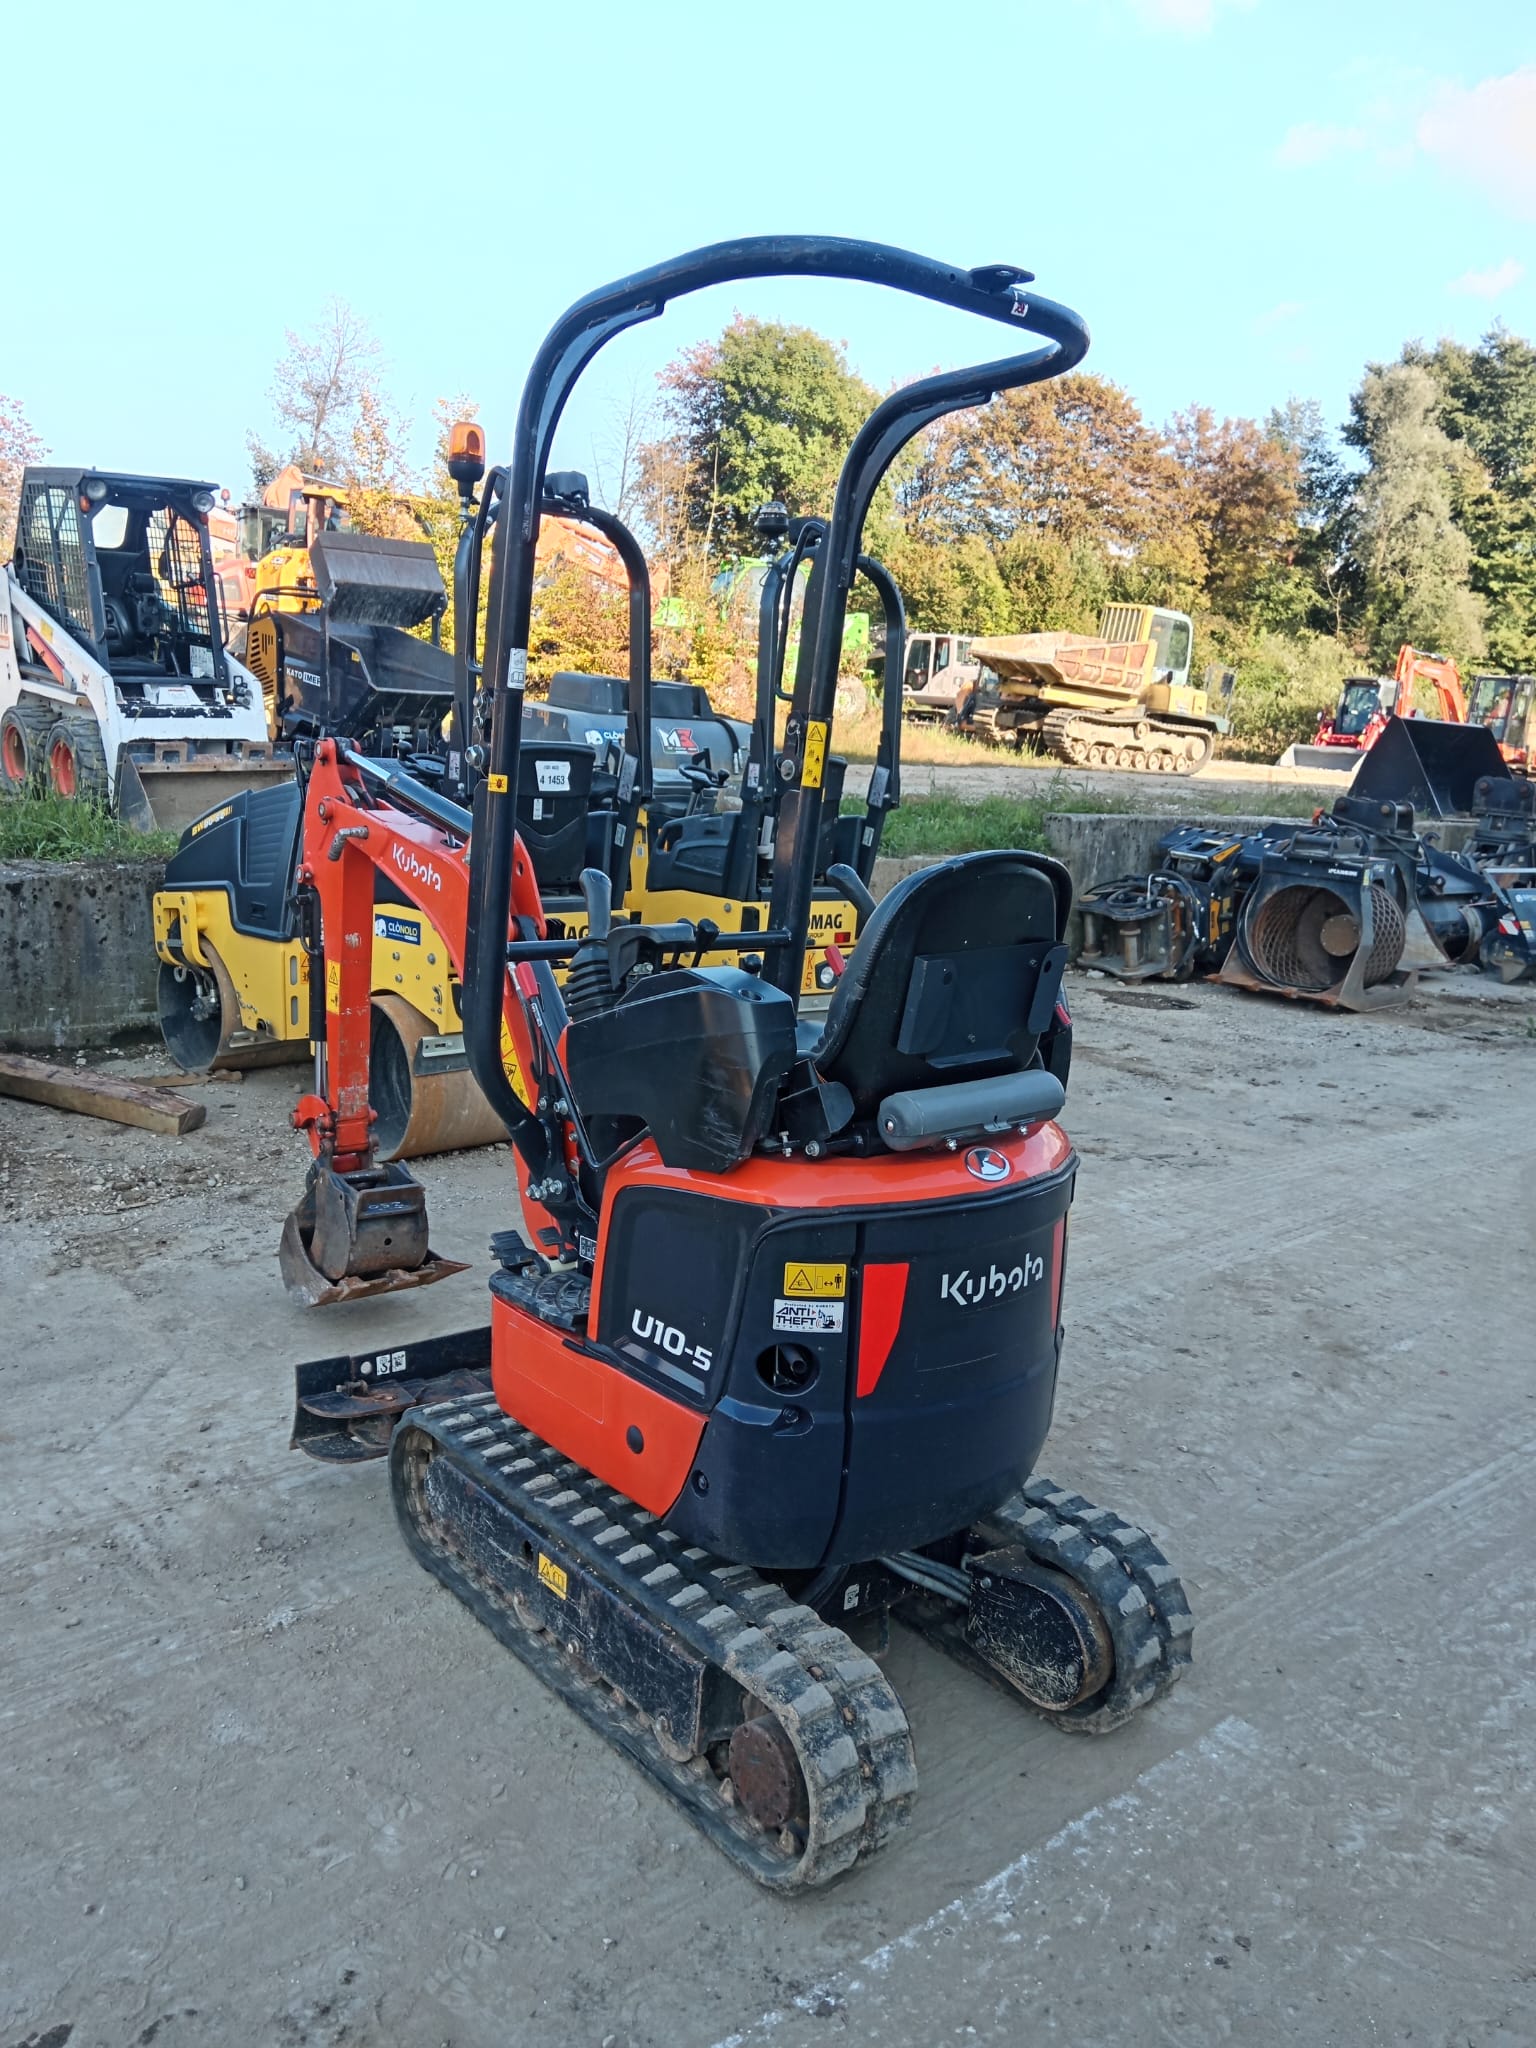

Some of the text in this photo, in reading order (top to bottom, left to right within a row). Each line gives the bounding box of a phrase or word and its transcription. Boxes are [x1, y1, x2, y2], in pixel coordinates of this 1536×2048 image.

[286, 667, 303, 680] KATO
[548, 775, 566, 785] 1453
[392, 842, 442, 892] Kubota
[387, 920, 418, 937] CLÒNOLO
[808, 913, 842, 930] MAG
[941, 1252, 1044, 1306] Kubota
[776, 1306, 810, 1316] ANTI
[775, 1315, 816, 1326] THEFT
[631, 1308, 713, 1372] U10-5
